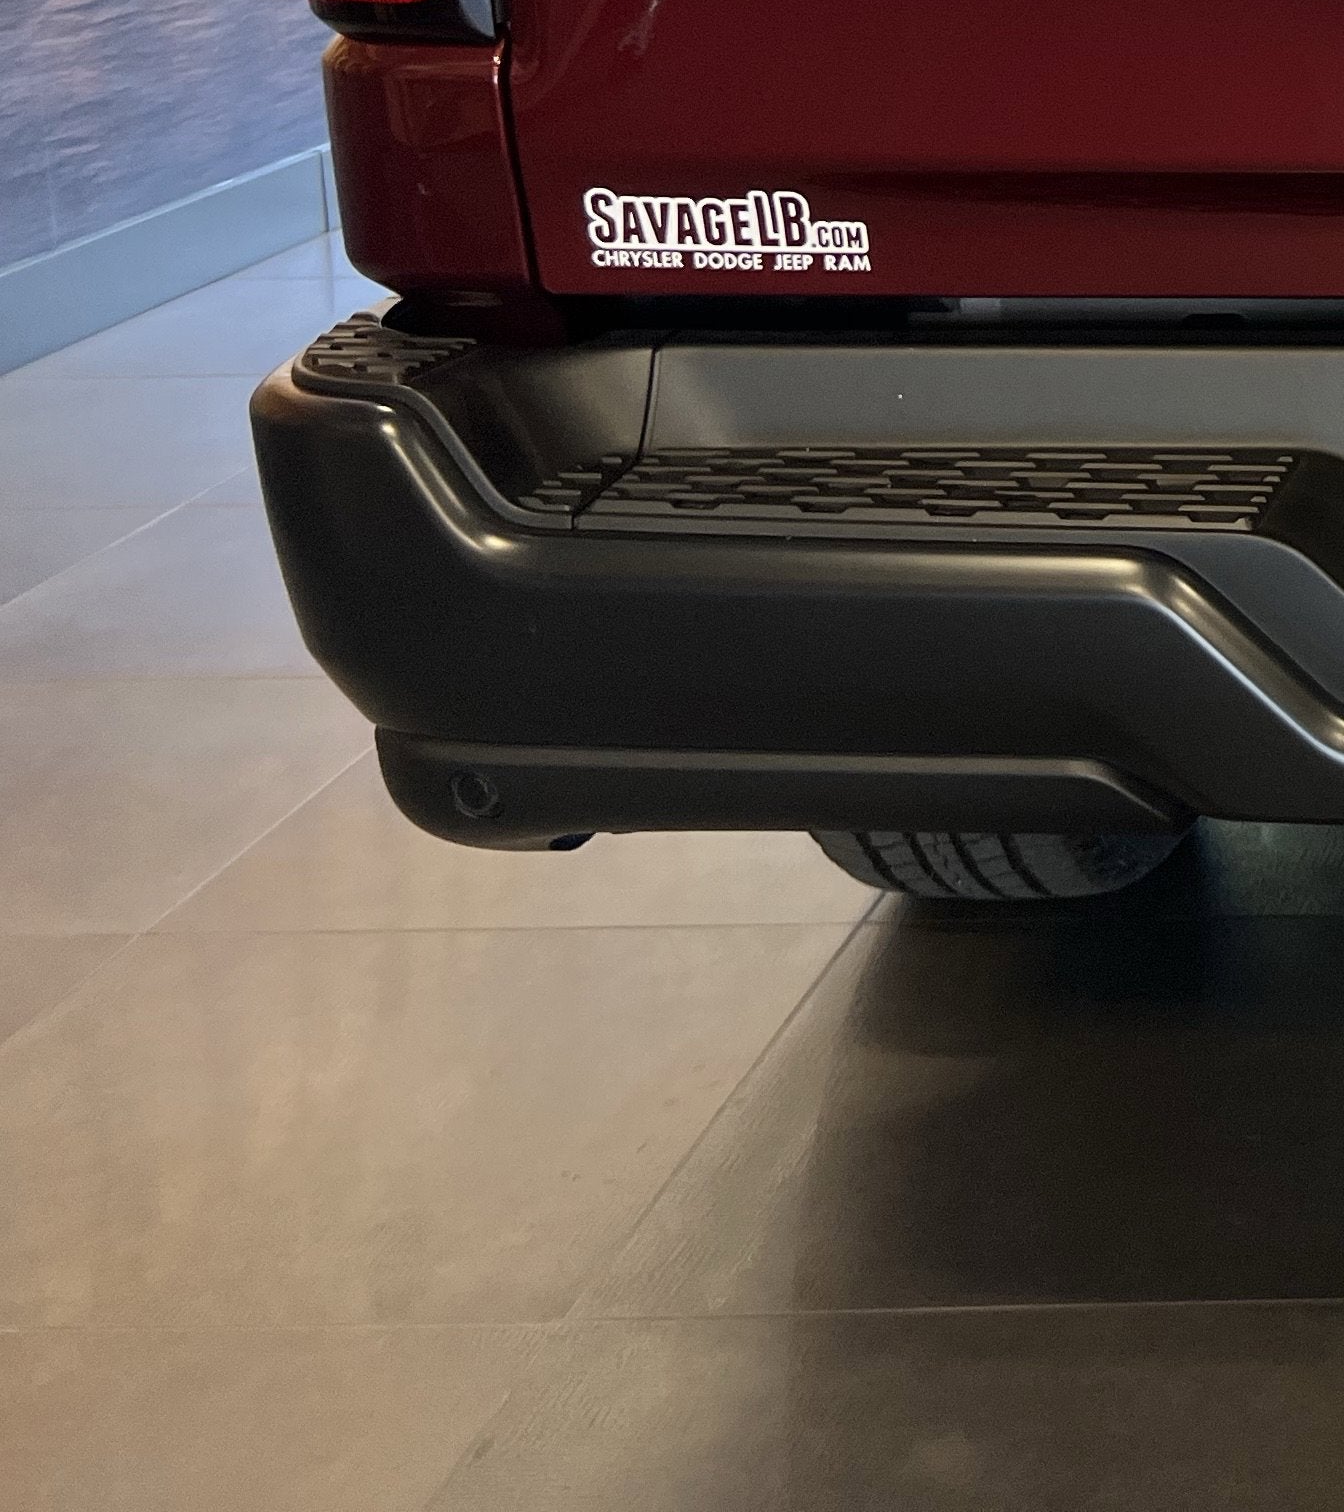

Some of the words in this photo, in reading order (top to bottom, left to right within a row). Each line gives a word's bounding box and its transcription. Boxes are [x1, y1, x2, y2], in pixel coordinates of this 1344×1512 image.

[592, 250, 684, 269] CHRYSLER
[693, 252, 764, 271] DODGE
[774, 253, 813, 272] JEEP
[824, 254, 872, 272] RAM
